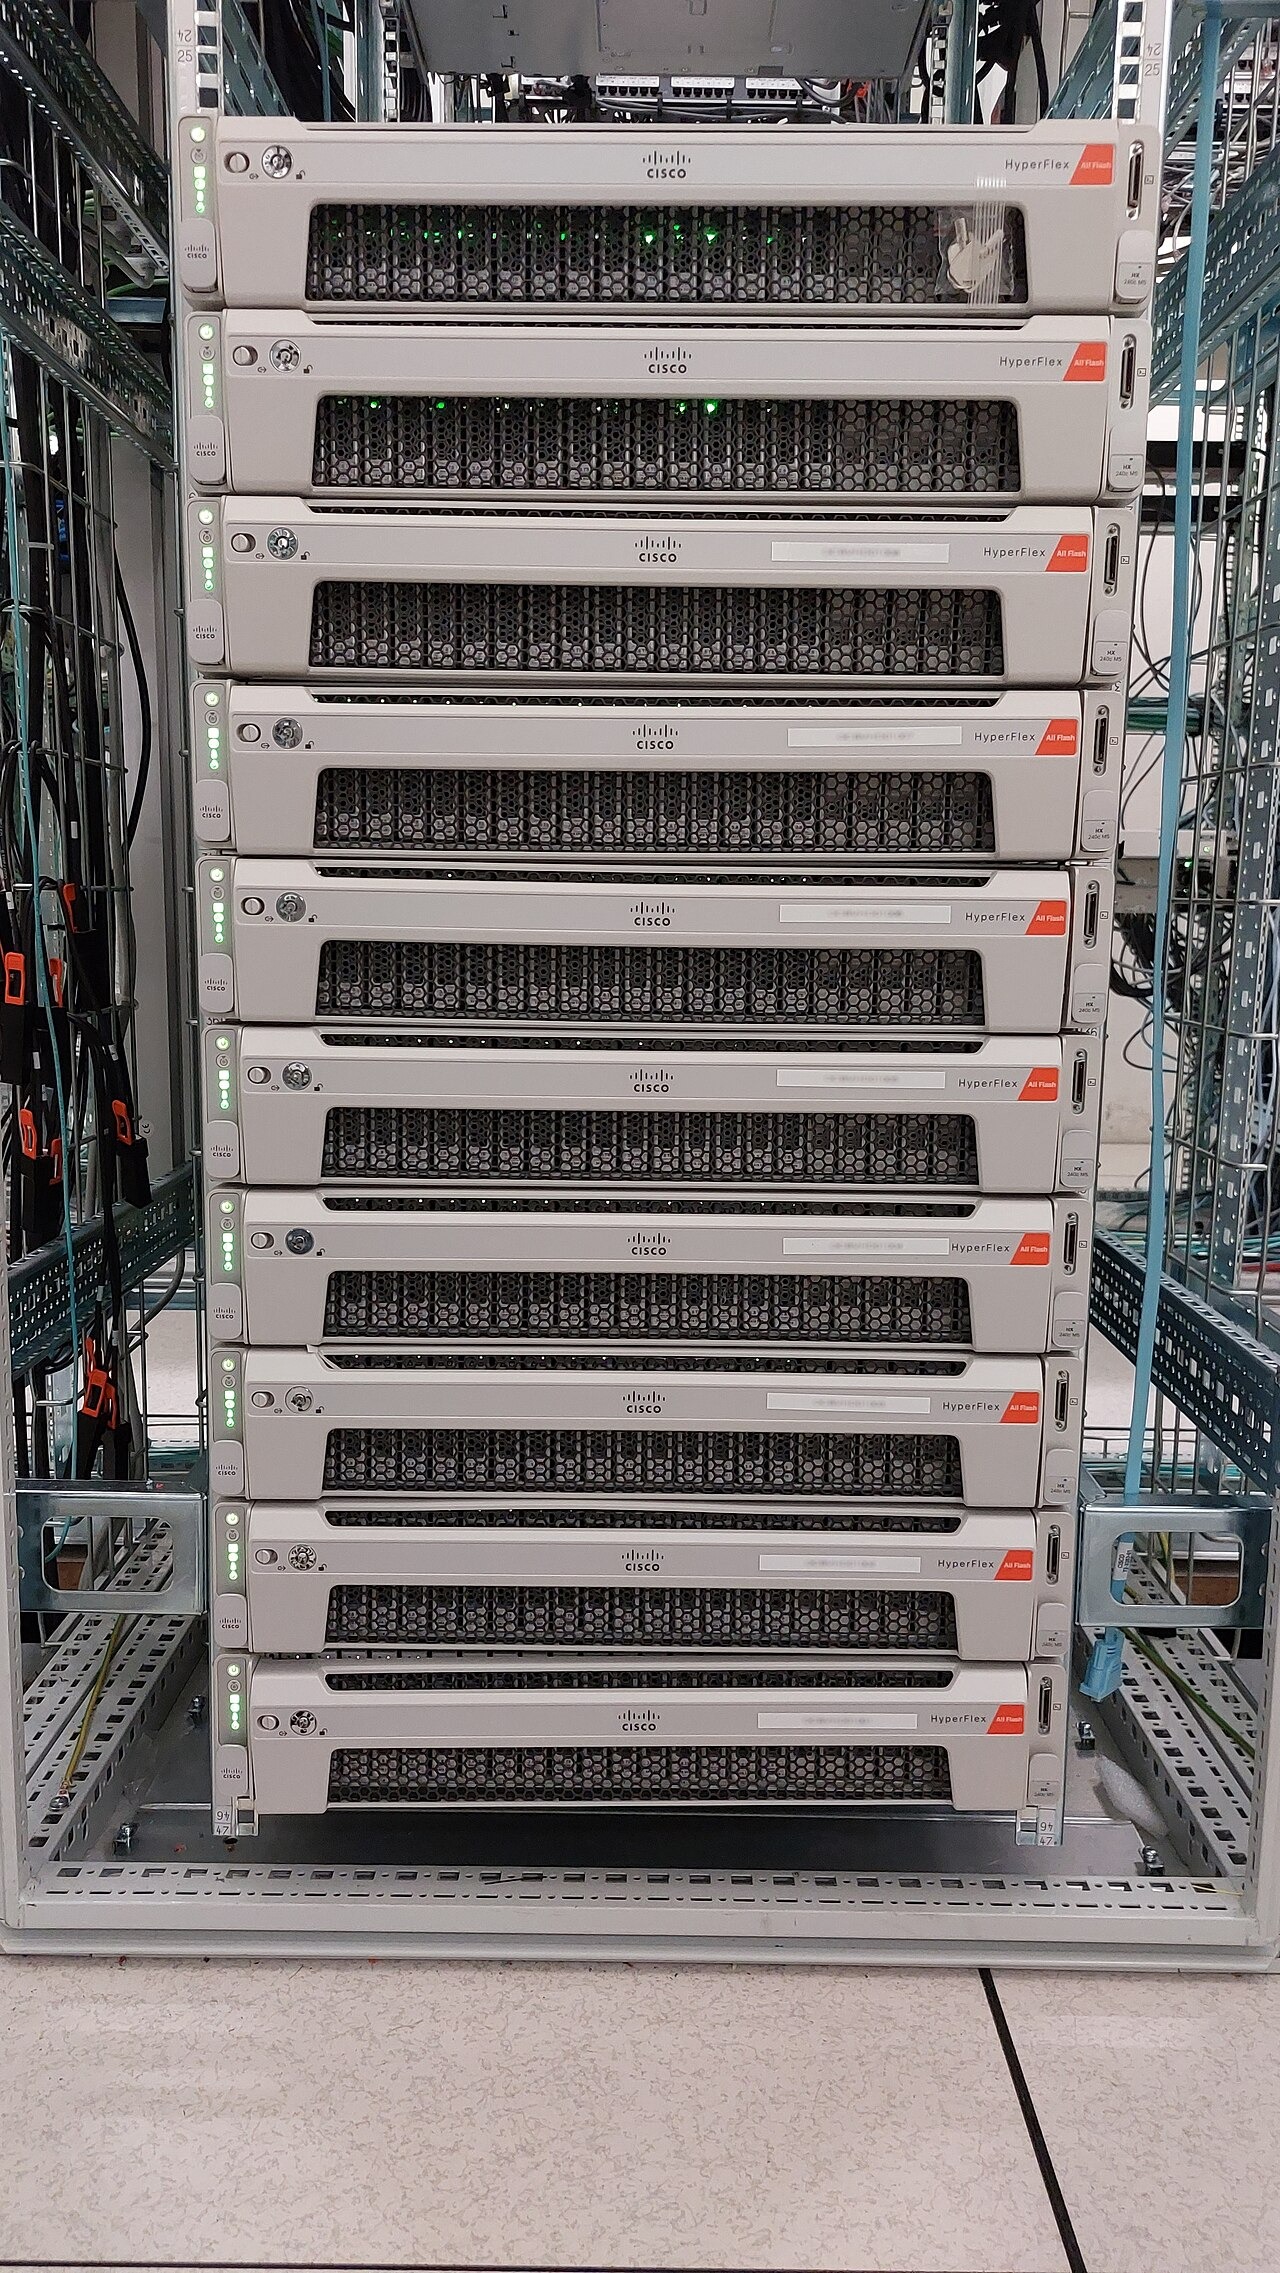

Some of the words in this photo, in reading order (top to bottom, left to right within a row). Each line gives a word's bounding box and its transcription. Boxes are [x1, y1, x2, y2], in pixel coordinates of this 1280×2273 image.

[178, 30, 192, 42] 24
[1148, 42, 1162, 56] 24
[178, 50, 192, 62] 25
[1144, 64, 1160, 76] 25
[1006, 159, 1069, 171] HyperFlex
[647, 168, 686, 178] CISCO
[1000, 357, 1062, 368] HyperFlex
[1074, 359, 1083, 367] All
[1085, 359, 1104, 367] Flash
[648, 364, 687, 374] CISCO
[639, 553, 677, 562] CISCO
[984, 548, 1045, 558] HyperFlex
[975, 733, 1034, 743] HyperFlex
[637, 740, 674, 750] CISCO
[634, 918, 671, 926] CISCO
[966, 913, 1025, 922] HyperFlex
[634, 1084, 669, 1092] CISCO
[959, 1079, 1017, 1089] HyperFlex
[632, 1246, 666, 1256] CISCO
[952, 1244, 1009, 1253] HyperFlex
[626, 1405, 662, 1414] CISCO
[943, 1402, 999, 1411] HyperFlex
[626, 1564, 660, 1572] CISCO
[938, 1560, 993, 1569] HyperFlex
[931, 1715, 986, 1724] HyperFlex
[622, 1723, 656, 1731] CISCO
[216, 1826, 229, 1835] 47
[1040, 1836, 1052, 1846] 47
